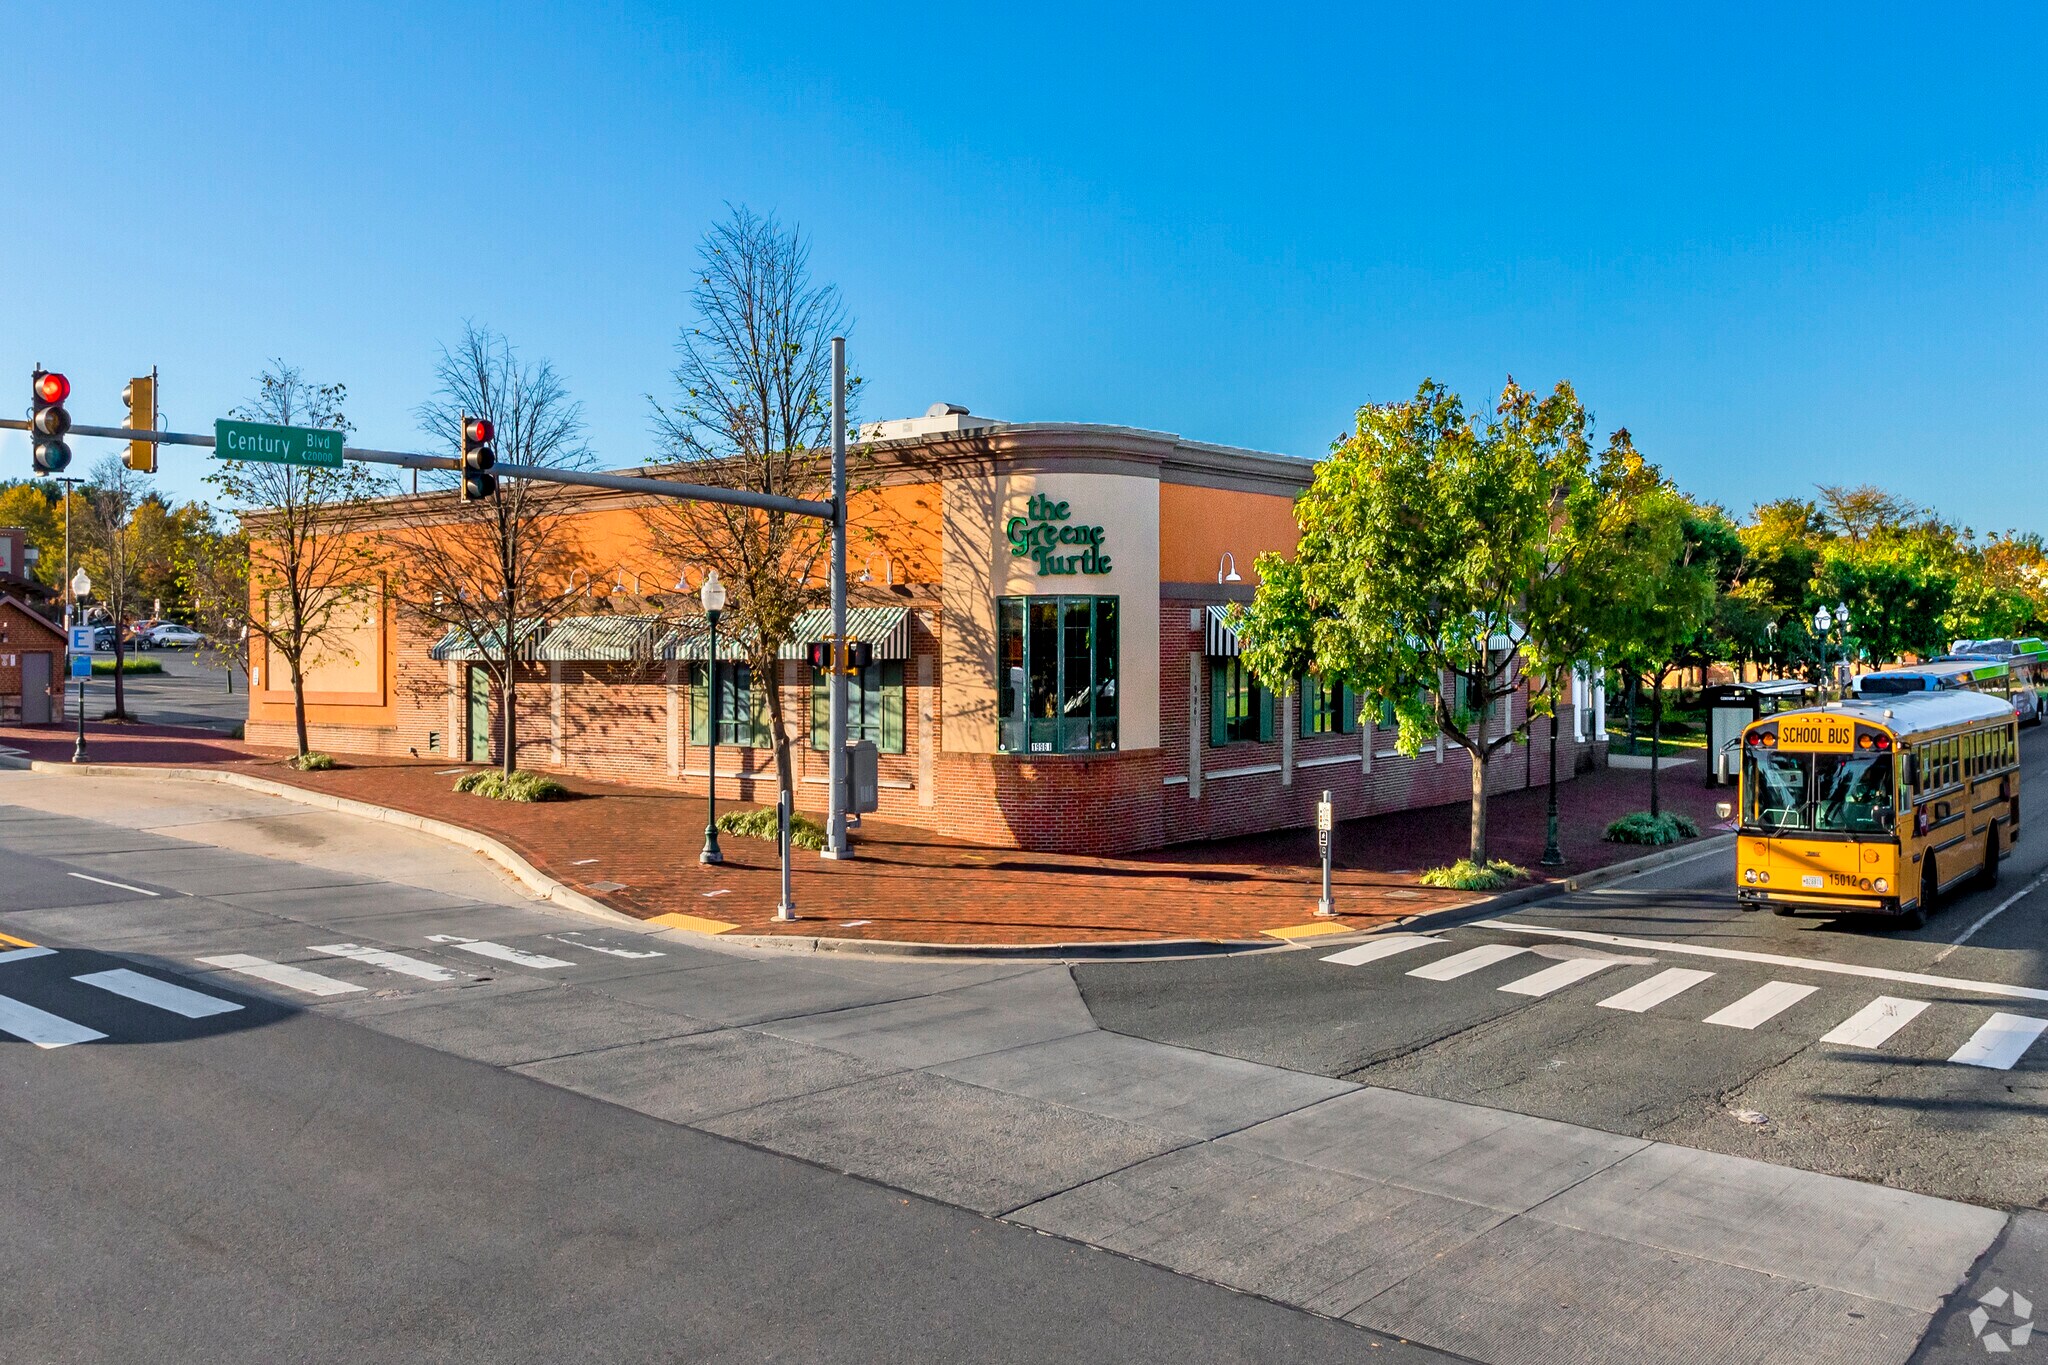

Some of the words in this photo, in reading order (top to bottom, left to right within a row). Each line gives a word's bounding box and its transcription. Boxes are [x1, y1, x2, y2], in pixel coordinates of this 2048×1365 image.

[227, 430, 290, 459] Century
[307, 433, 330, 449] Blvd
[307, 451, 333, 463] 20000
[1026, 493, 1071, 521] the
[1007, 516, 1106, 557] Greene
[1031, 544, 1113, 576] Turtle
[74, 629, 89, 648] E
[1783, 727, 1823, 743] SCHOOL
[1828, 728, 1850, 744] BUS
[1829, 873, 1857, 887] 15012
